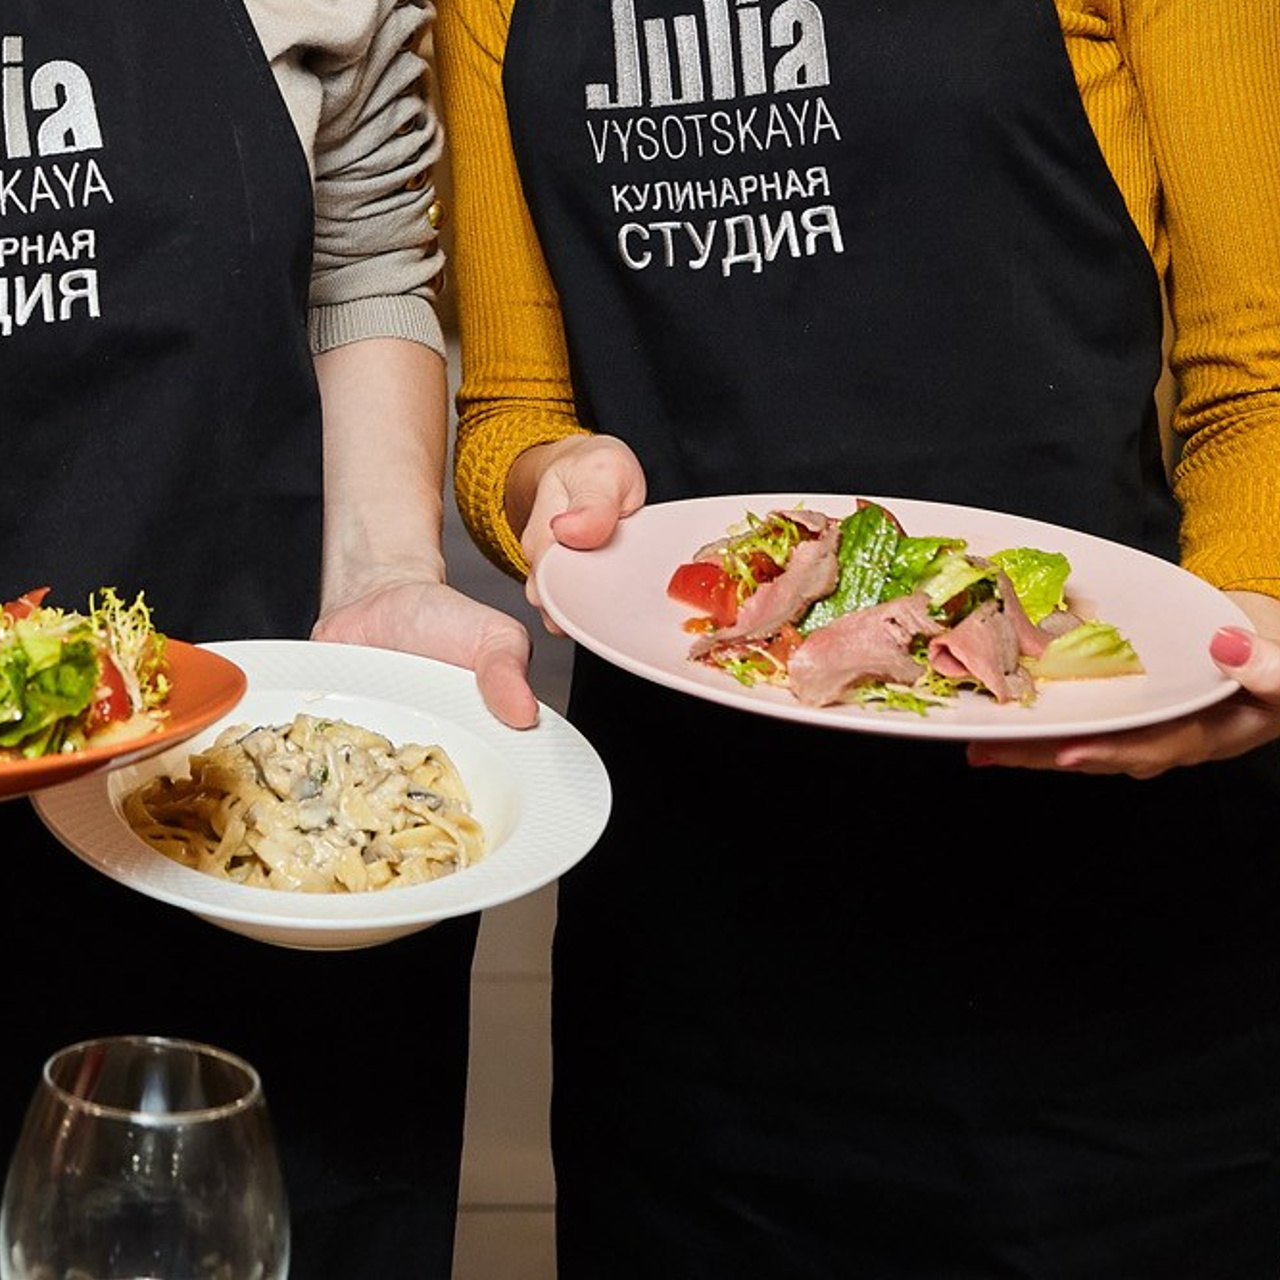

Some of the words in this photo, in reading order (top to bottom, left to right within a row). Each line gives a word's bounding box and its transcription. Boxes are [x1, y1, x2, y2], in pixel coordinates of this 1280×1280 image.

[586, 97, 841, 163] VYSOTSKAYA
[611, 167, 830, 212] КУЛИНАРНАЯ
[617, 205, 844, 276] СТУДИЯ
